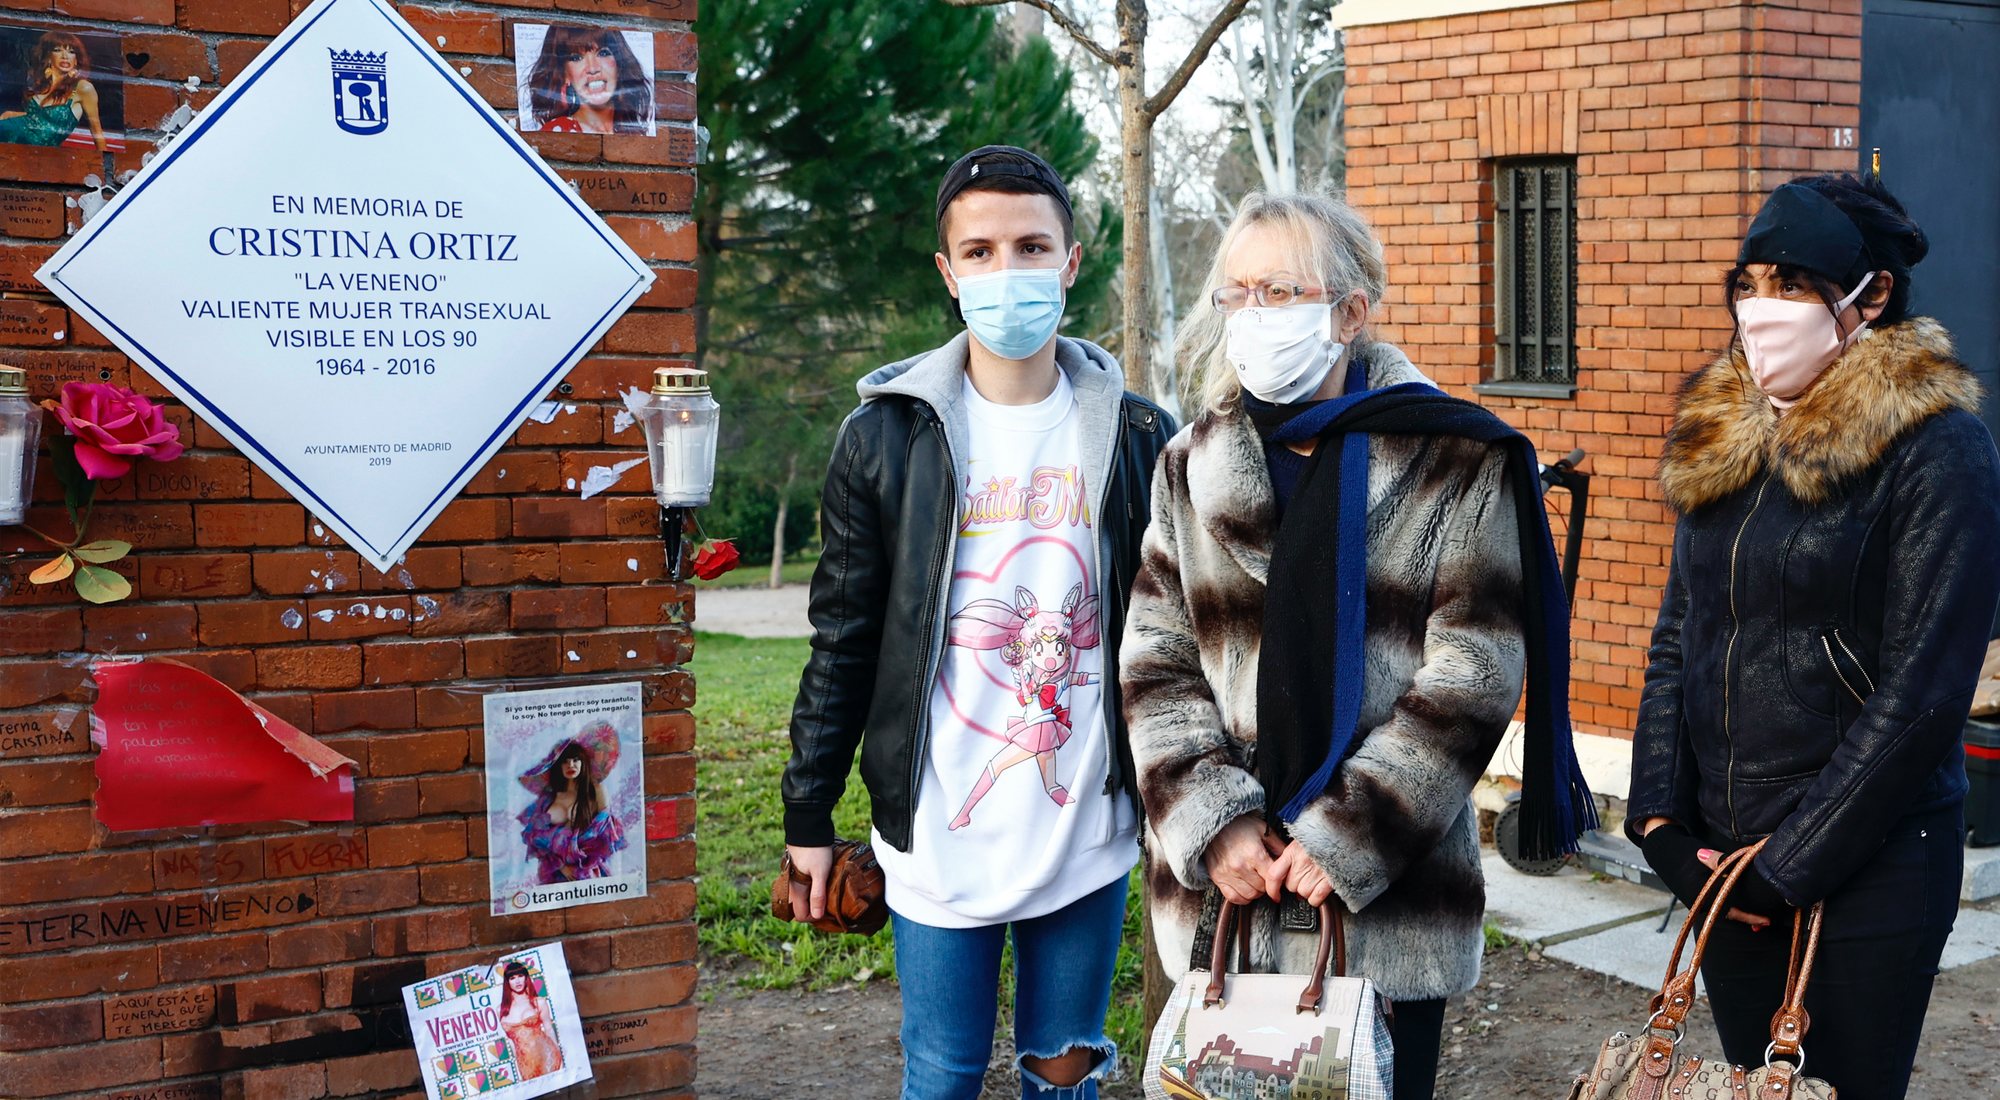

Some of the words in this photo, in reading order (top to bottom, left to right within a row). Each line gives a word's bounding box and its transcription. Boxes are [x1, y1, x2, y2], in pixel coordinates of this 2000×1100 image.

[577, 177, 628, 190] VUELA
[272, 195, 304, 214] EN
[313, 196, 428, 218] MEMORIA
[435, 200, 463, 219] DE
[631, 191, 668, 205] ALTO
[208, 226, 400, 259] CRISTINA
[409, 231, 518, 262] ORTIZ
[294, 272, 335, 290] "LA
[339, 272, 446, 292] VENENO"
[181, 299, 301, 319] VALIENTE
[309, 300, 392, 320] MUJER
[399, 301, 551, 320] TRANSEXUAL
[265, 329, 356, 348] VISIBLE
[363, 329, 394, 348] EN
[403, 329, 446, 348] LOS
[453, 330, 477, 348] 90
[316, 358, 366, 376] 1964
[387, 357, 436, 376] 2016
[304, 443, 391, 455] AYUNTAMIENTO
[393, 443, 407, 453] DE
[410, 442, 452, 453] MADRID
[369, 457, 392, 466] 2019
[513, 706, 524, 714] yo
[524, 704, 547, 713] tengo
[547, 702, 562, 710] que
[586, 698, 600, 707] soy
[537, 711, 549, 719] No
[549, 709, 571, 718] tengo
[572, 708, 585, 716] por
[601, 704, 630, 713] negarlo
[161, 850, 245, 880] NAIS
[271, 840, 367, 874] FUERA
[532, 881, 629, 905] tarantulismo
[154, 895, 295, 935] VENENO
[193, 993, 209, 1004] EL
[469, 993, 492, 1011] La
[111, 1008, 175, 1023] FUNERAL
[179, 1004, 205, 1016] QUE
[115, 1025, 132, 1036] TE
[141, 1017, 205, 1034] MERECES
[425, 1006, 499, 1049] VENENO
